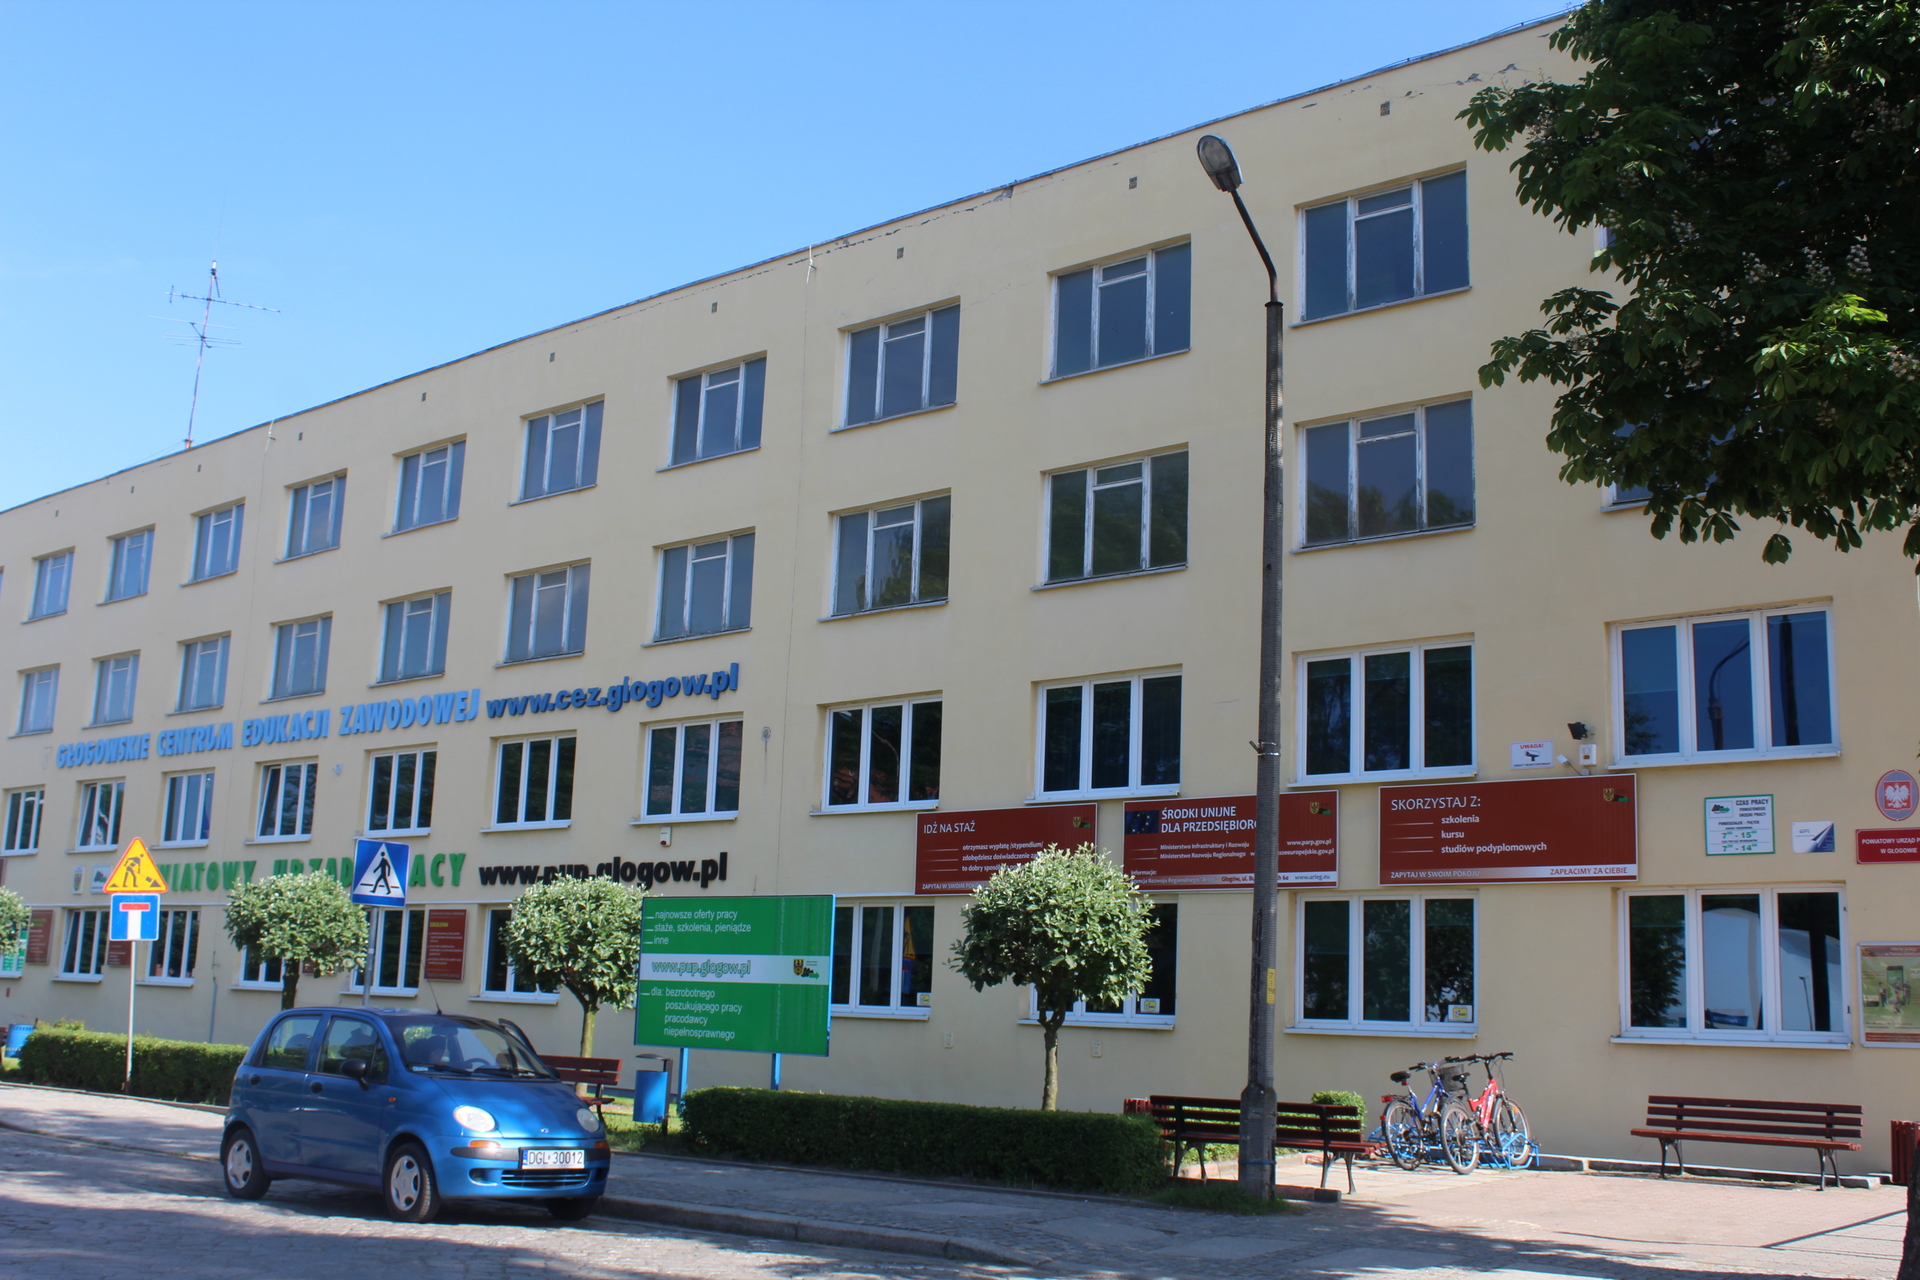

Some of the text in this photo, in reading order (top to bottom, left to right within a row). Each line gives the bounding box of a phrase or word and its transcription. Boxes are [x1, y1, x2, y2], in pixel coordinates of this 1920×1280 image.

[56, 662, 739, 768] GŁOGOWSKIE CENTRUM EDUKACJI ZAWODOWEJ www.cez.glogow.pl
[1390, 796, 1481, 811] SKORZYSTAJ Z:
[1162, 806, 1236, 820] ŚRODKI UNIJNE
[1441, 815, 1480, 824] szkolenia
[924, 820, 976, 834] IDŹ NA STAŻ
[1161, 819, 1257, 834] DLA PRZEDSIĘBIOR
[1441, 830, 1464, 839] kursu
[1441, 842, 1547, 855] studiów podyplomowych
[408, 853, 466, 887] ACY
[1550, 867, 1592, 876] ZAPŁACIMY
[1604, 866, 1628, 874] CIEBIE
[655, 909, 737, 921] najnowsze oferty pracy
[654, 923, 752, 934] staże, szkolenia, pieniądze
[654, 936, 669, 945] inne
[651, 960, 751, 978] www.pup.glogow.pl
[651, 987, 715, 1000] dla: bezrobotnego
[665, 1001, 742, 1015] poszukującego pracy
[664, 1014, 708, 1026] pracodawcy
[664, 1027, 735, 1041] niepełnosprawnego
[528, 1151, 583, 1164] DGL 30012
